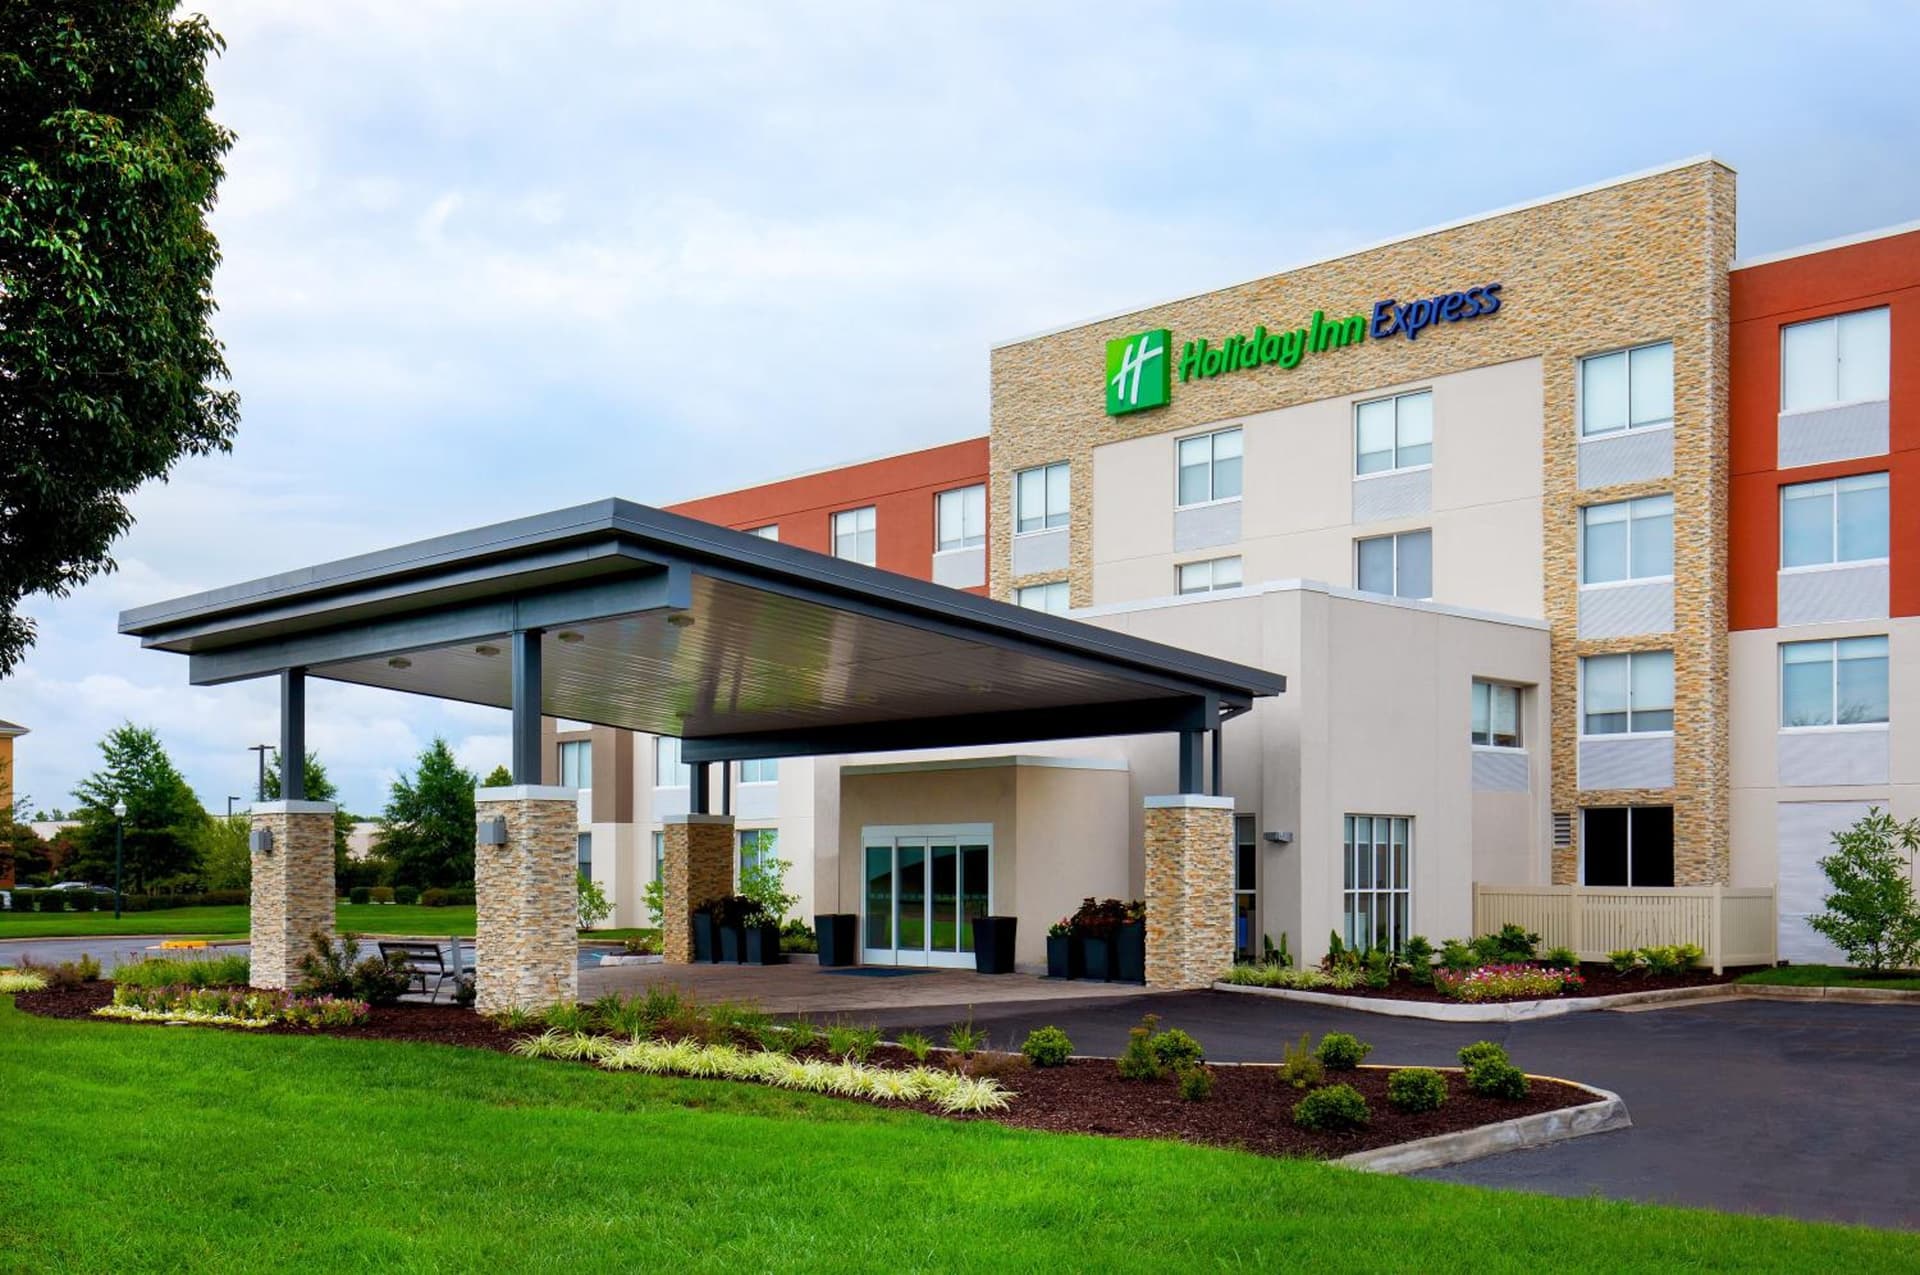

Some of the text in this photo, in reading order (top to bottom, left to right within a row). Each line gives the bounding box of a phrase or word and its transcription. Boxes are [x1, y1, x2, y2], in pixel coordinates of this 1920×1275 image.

[1179, 283, 1502, 382] Holiday Inn Express
